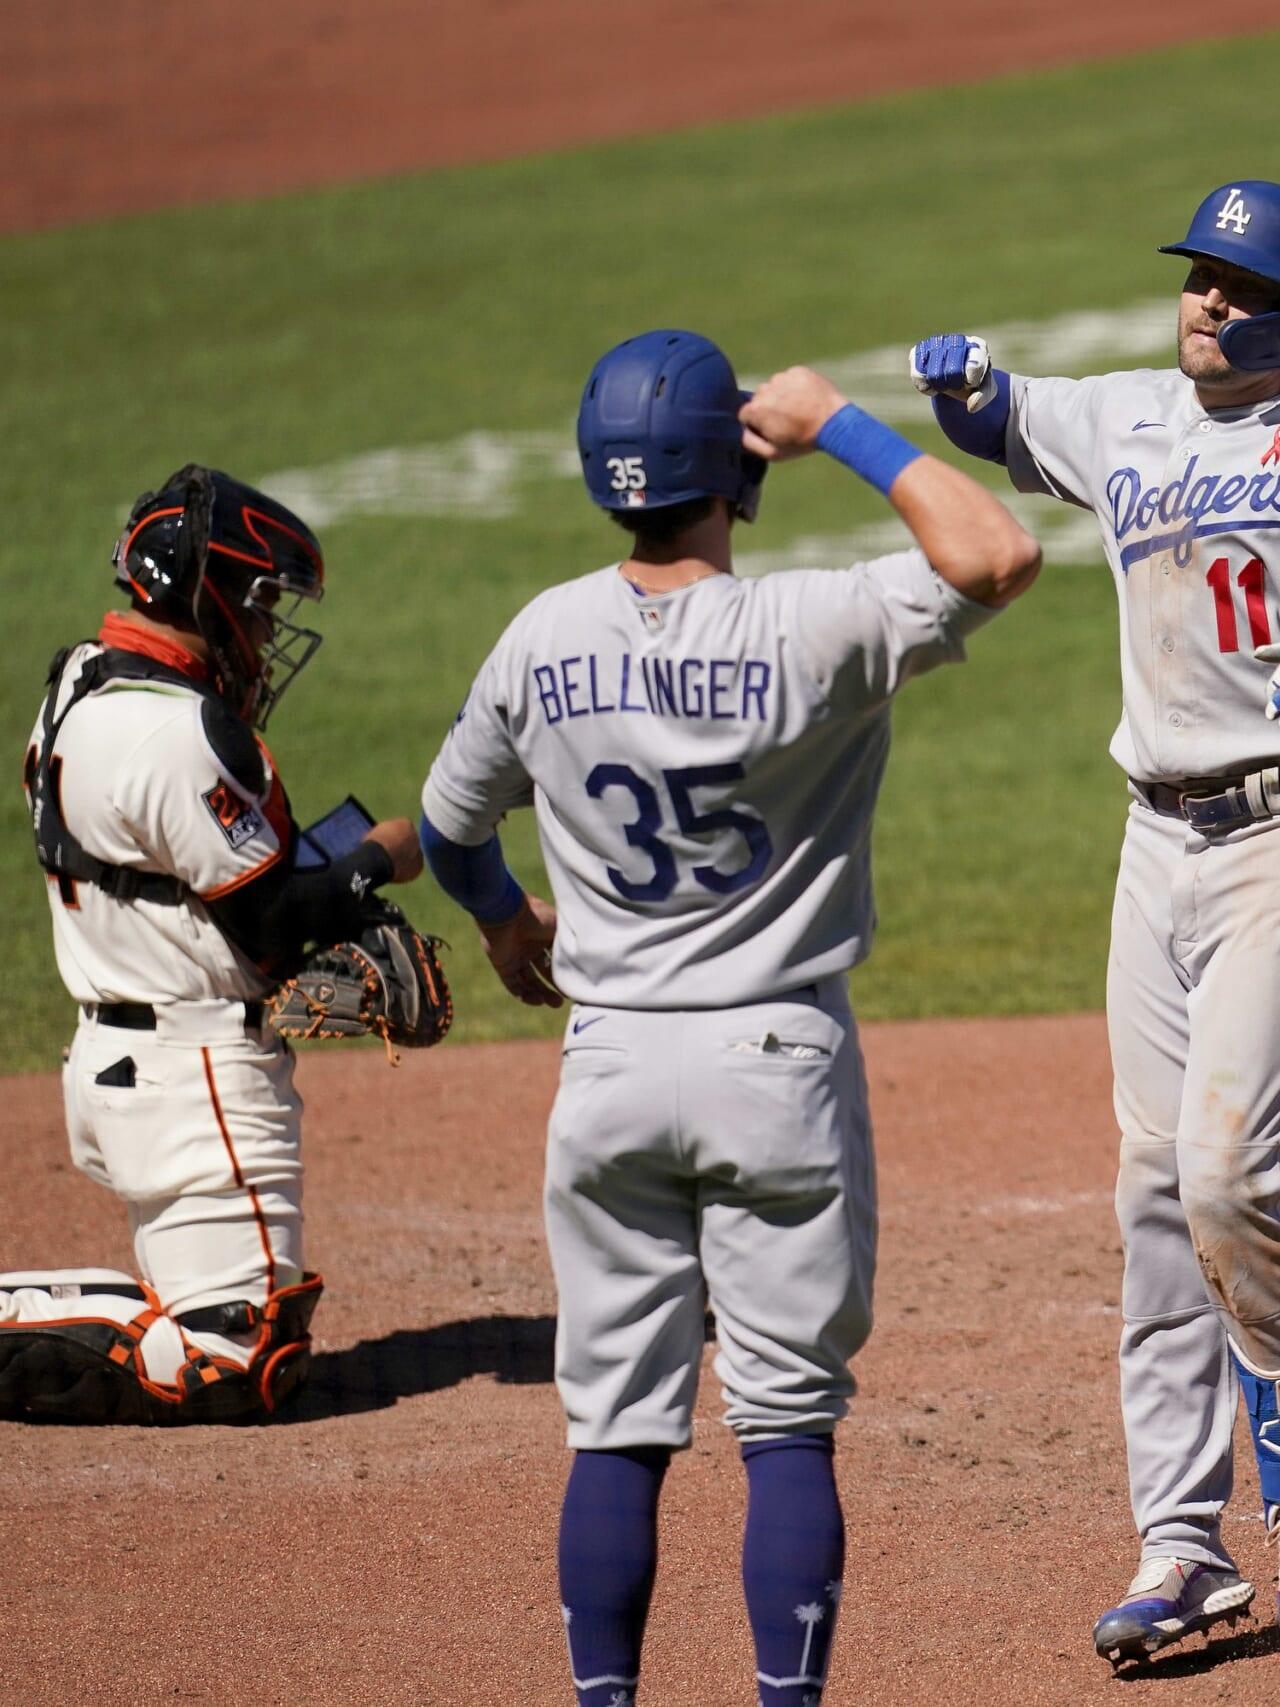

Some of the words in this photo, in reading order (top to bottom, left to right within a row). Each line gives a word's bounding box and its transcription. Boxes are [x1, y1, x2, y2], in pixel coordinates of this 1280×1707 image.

[1215, 188, 1251, 236] LA
[606, 456, 648, 490] 35
[1205, 557, 1273, 653] 11
[533, 653, 771, 725] BELLINGER
[584, 761, 774, 902] 35
